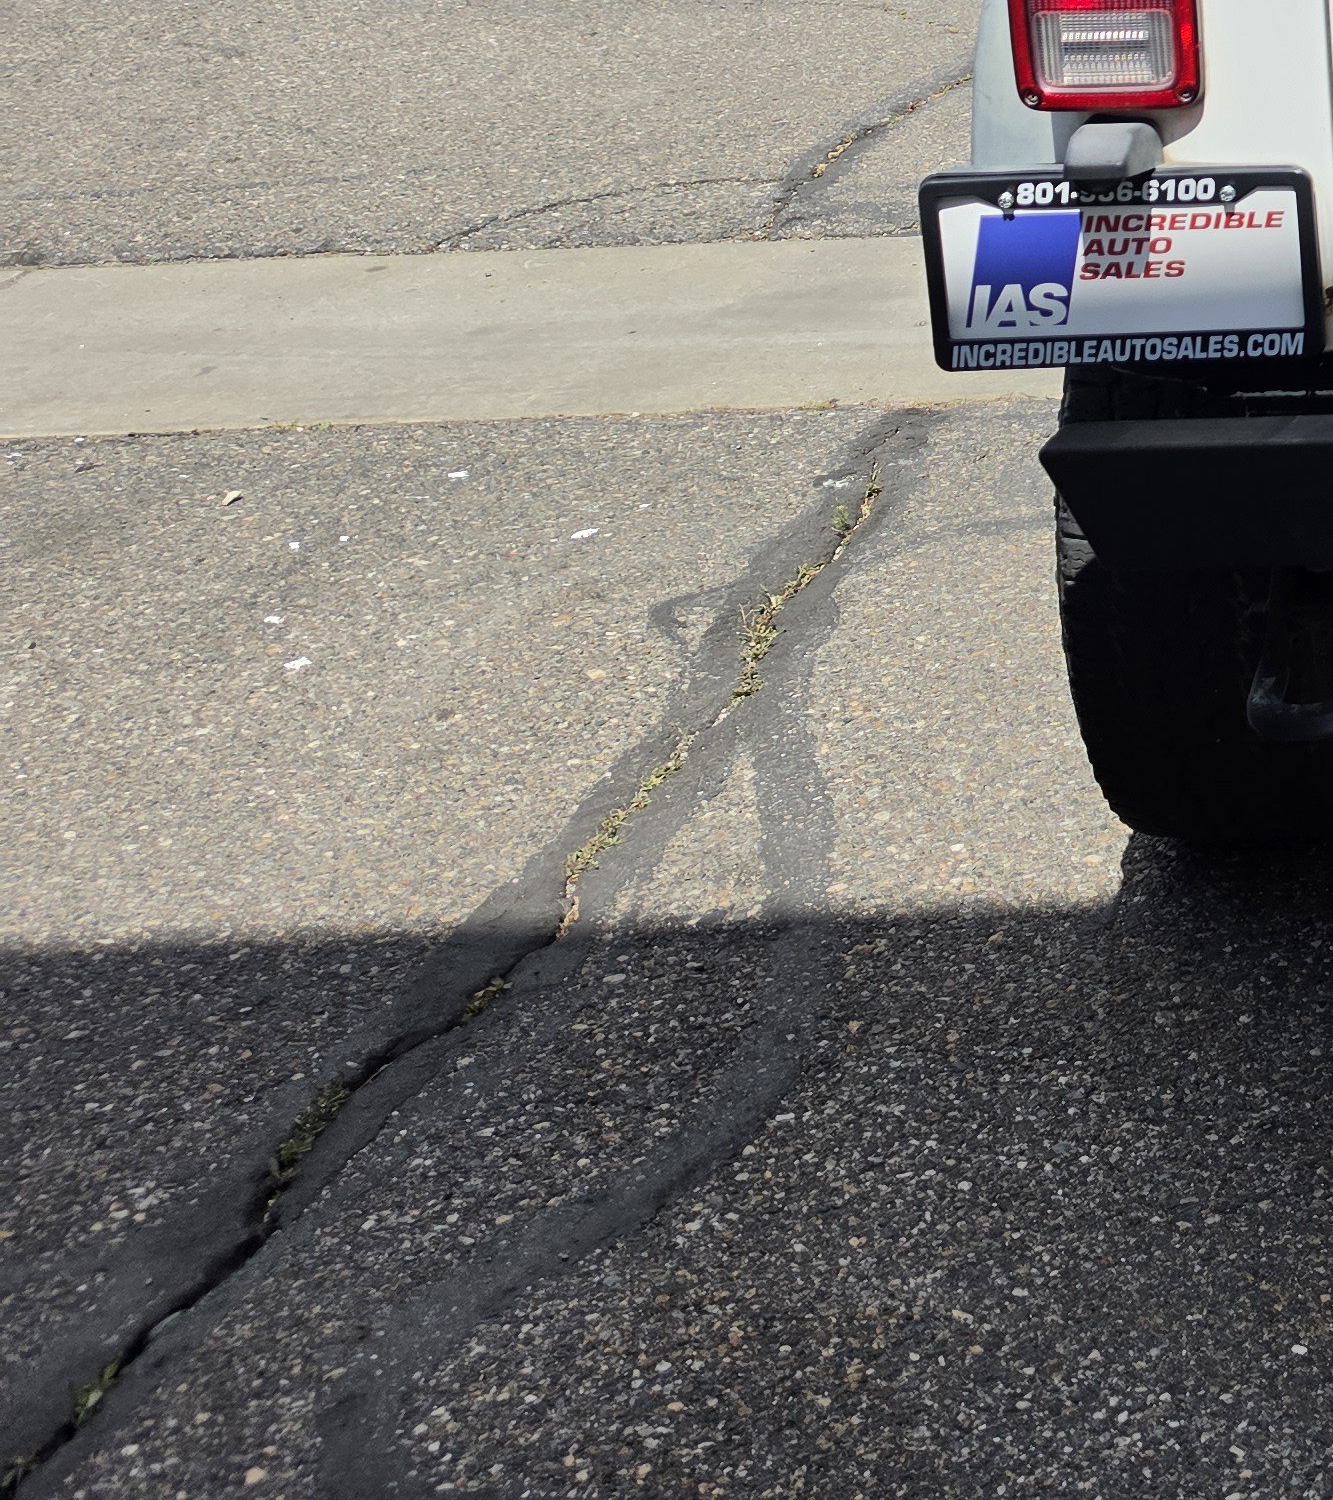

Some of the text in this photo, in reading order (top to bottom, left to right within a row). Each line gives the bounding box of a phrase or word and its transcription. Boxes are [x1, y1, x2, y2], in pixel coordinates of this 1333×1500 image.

[1084, 211, 1284, 234] INCREDIBLE
[1082, 237, 1172, 257] AUTO
[1080, 260, 1186, 280] SALES
[969, 282, 1068, 329] IAS
[952, 333, 1304, 369] INCREDIBLEAUTOSALES.COM
